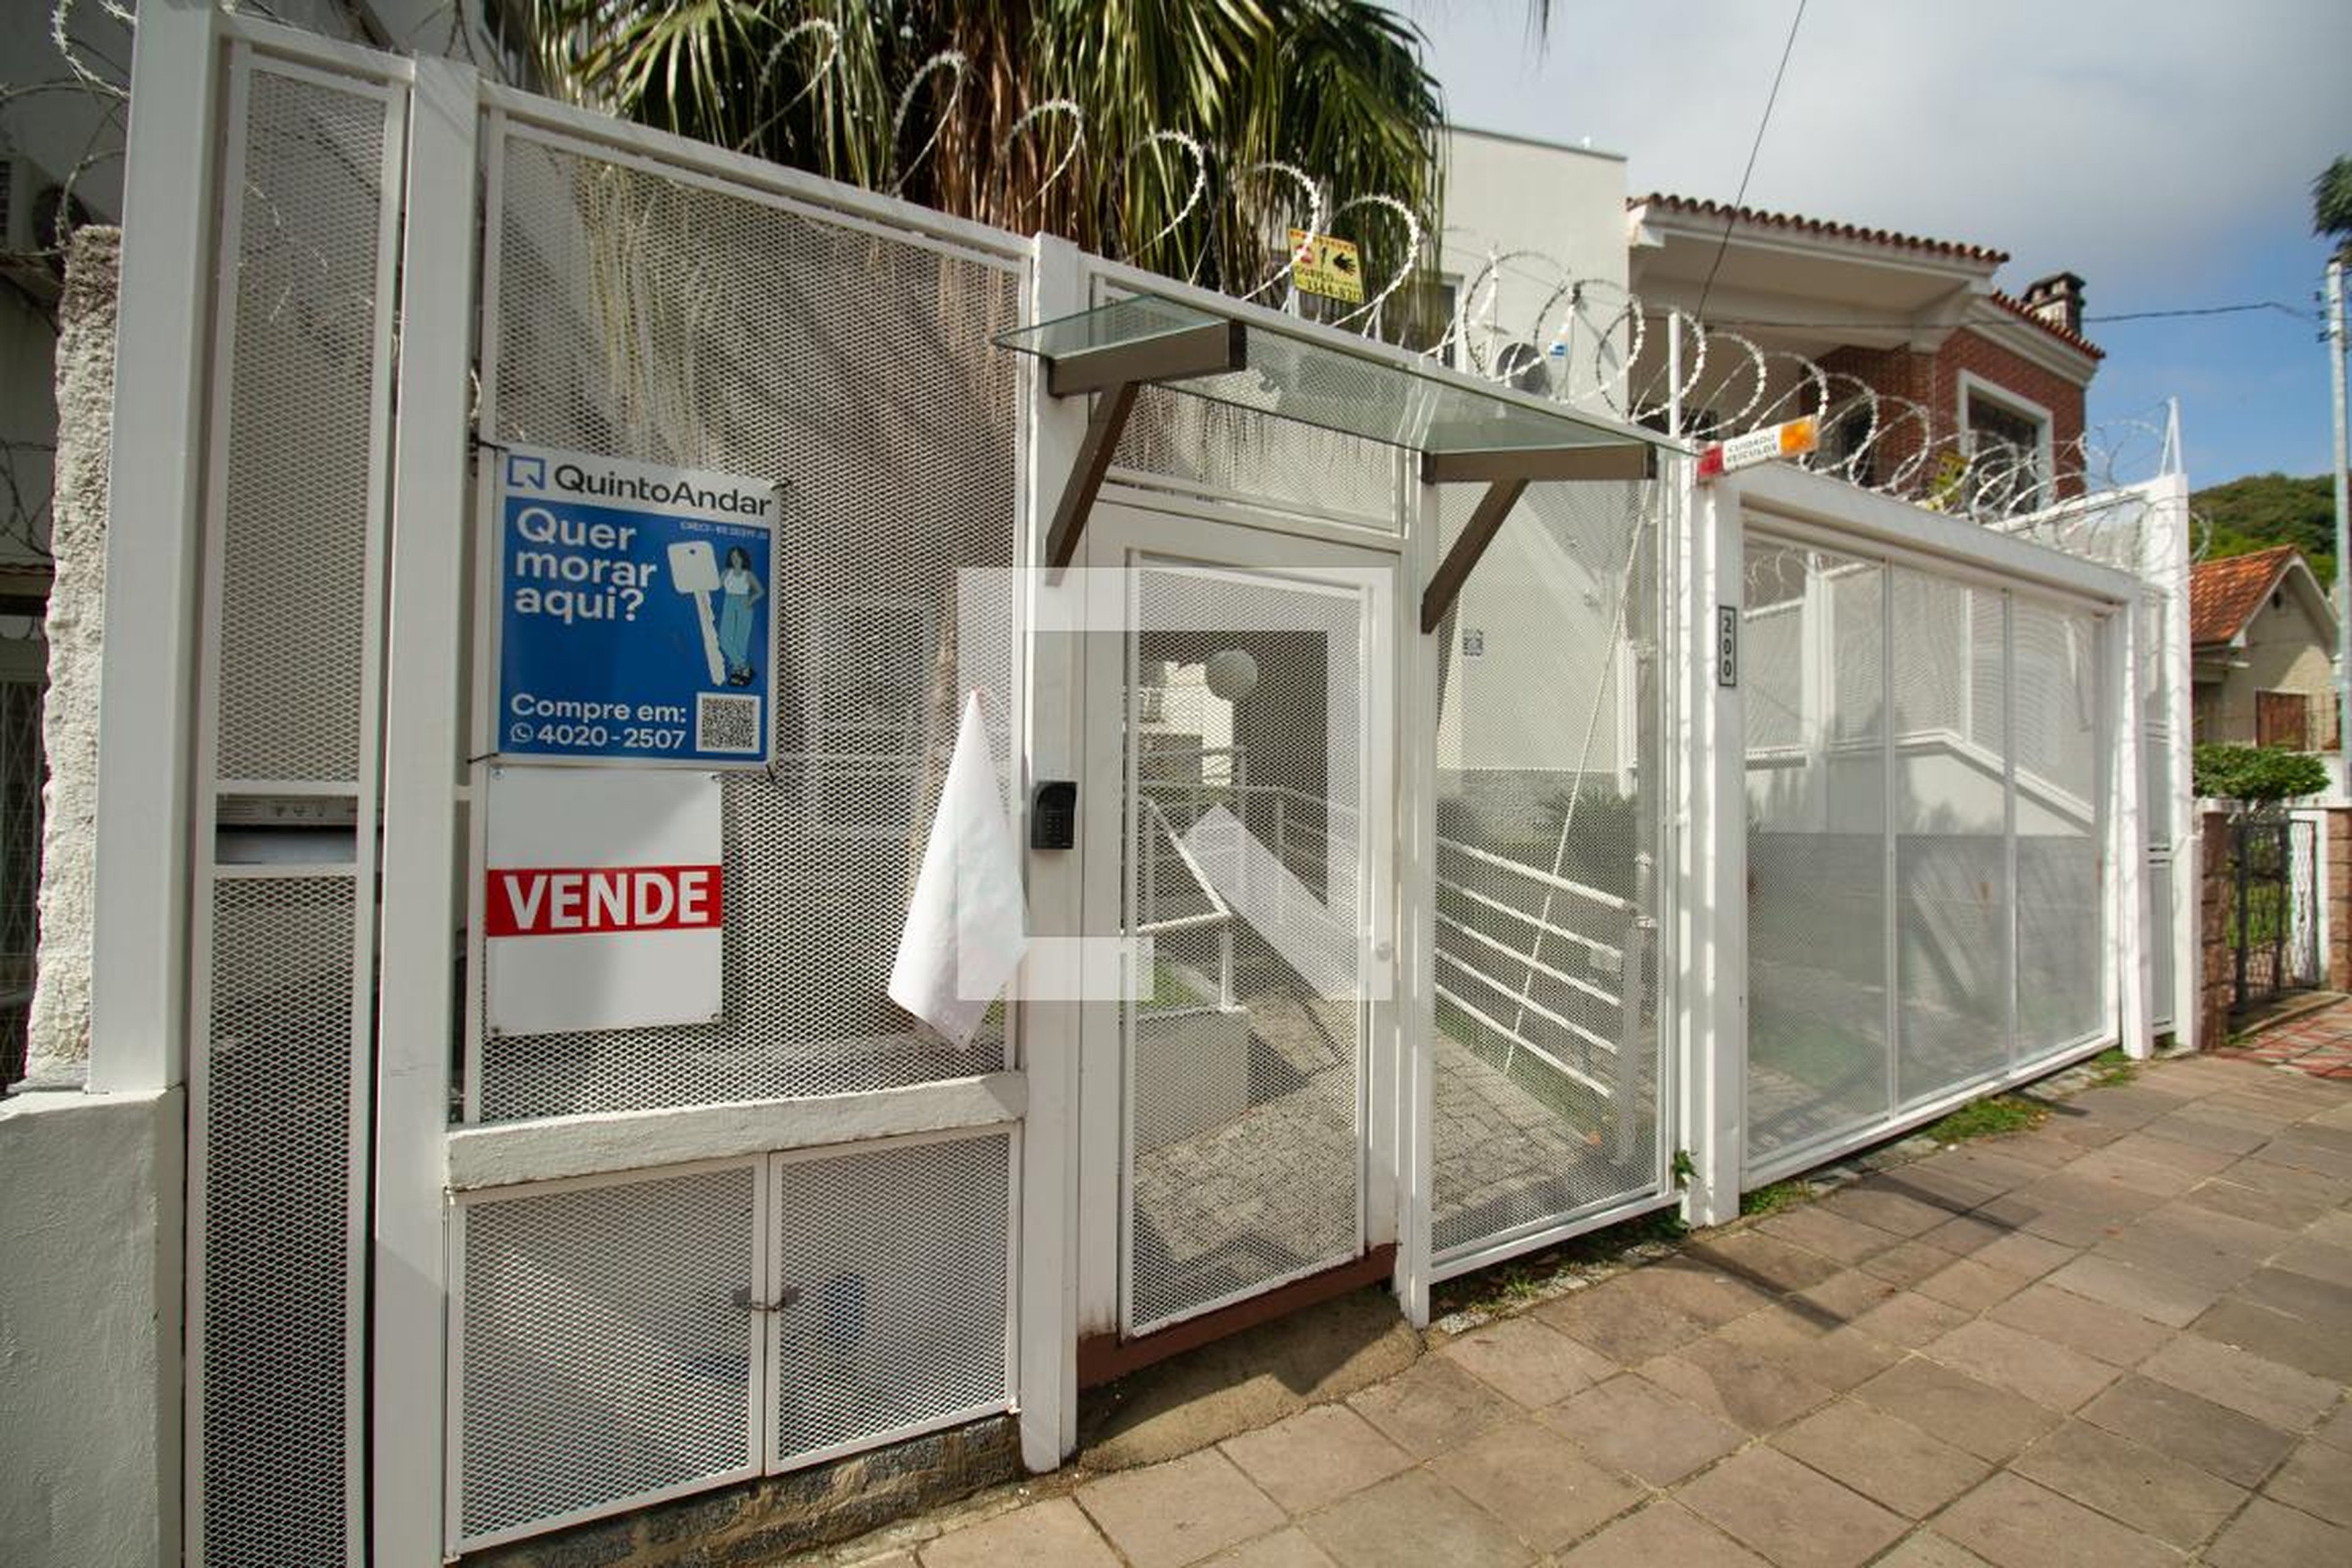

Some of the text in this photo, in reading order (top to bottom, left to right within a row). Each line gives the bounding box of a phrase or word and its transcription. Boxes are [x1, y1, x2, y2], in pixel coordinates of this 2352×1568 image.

[555, 464, 772, 517] QuintoAndar
[517, 507, 637, 551] Quer
[515, 551, 657, 587] morar
[514, 586, 644, 625] aqui?
[1723, 616, 1732, 677] 200
[510, 693, 687, 723] Compre em:
[503, 871, 709, 930] VENDE
